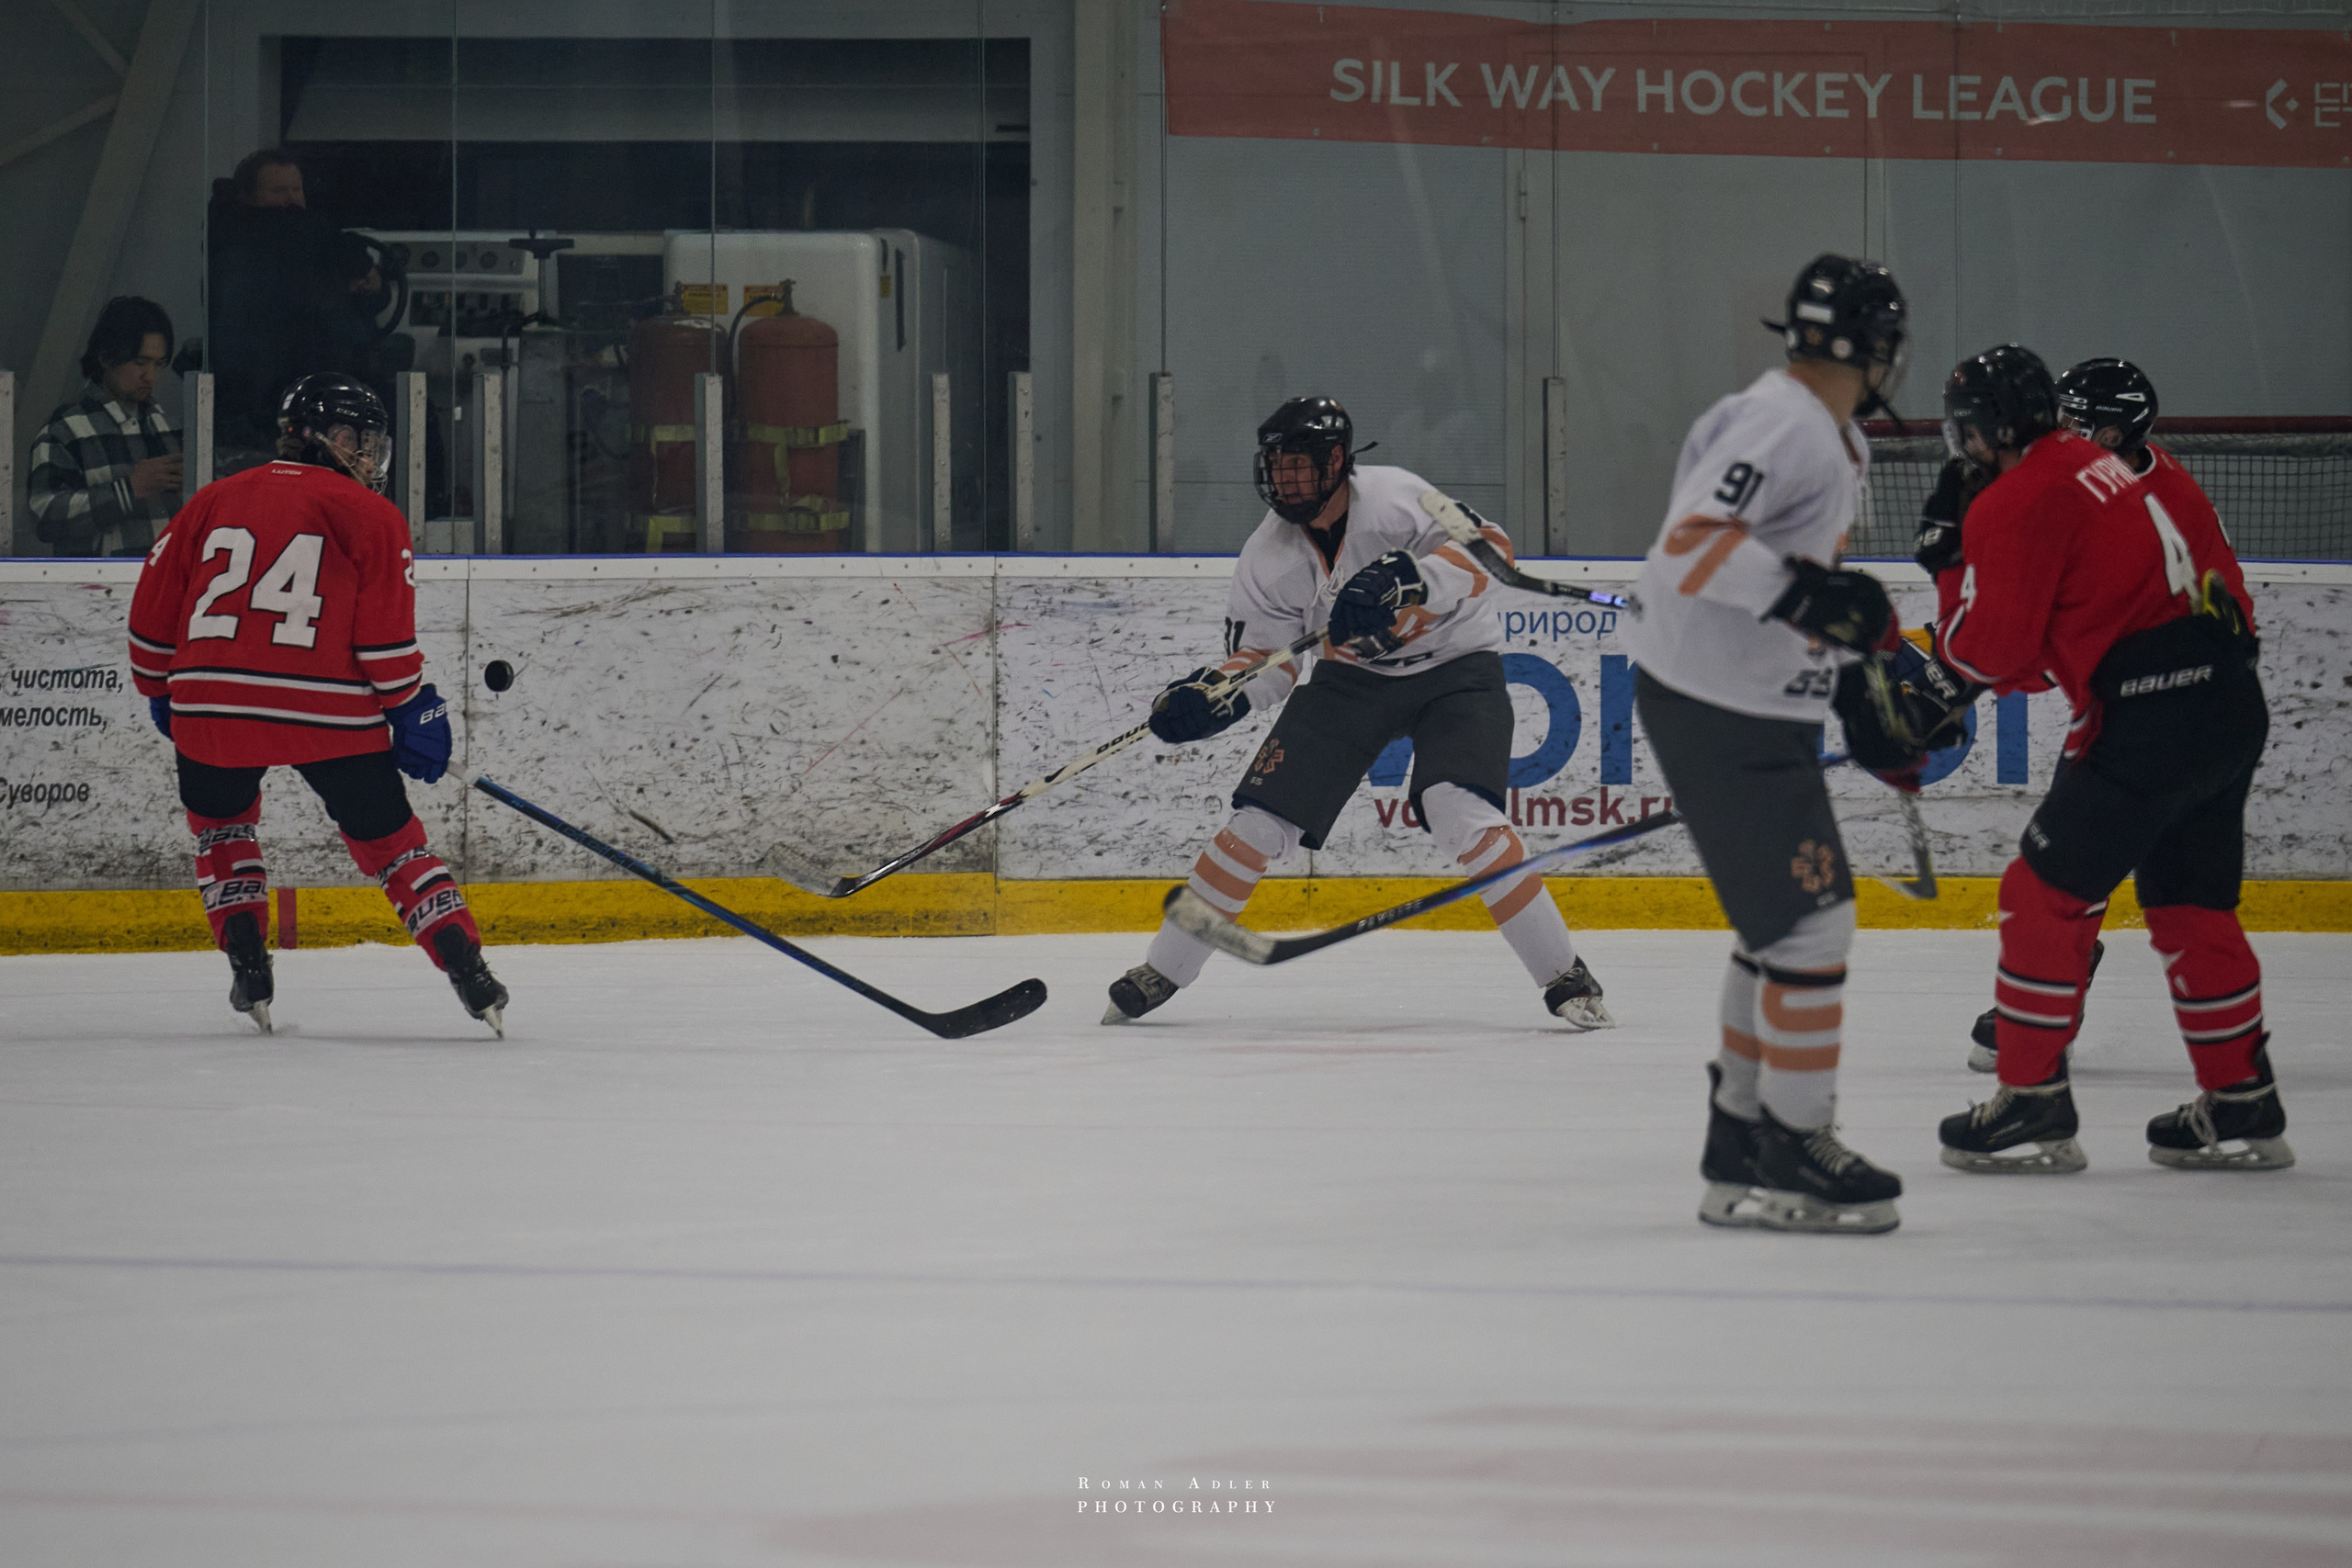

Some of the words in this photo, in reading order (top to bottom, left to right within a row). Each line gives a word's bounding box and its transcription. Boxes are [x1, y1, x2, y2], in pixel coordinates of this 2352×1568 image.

[1330, 59, 1463, 107] SILK
[1480, 63, 1615, 111] WAY
[1636, 69, 1893, 118] HOCKEY
[1912, 73, 2157, 123] LEAGUE
[1714, 462, 1764, 516] 91
[2143, 492, 2202, 606] 4
[187, 526, 325, 649] 24
[1959, 562, 1978, 614] 4
[1497, 610, 1617, 642] рирод
[11, 669, 123, 694] чистота,
[2120, 663, 2214, 698] BAUER
